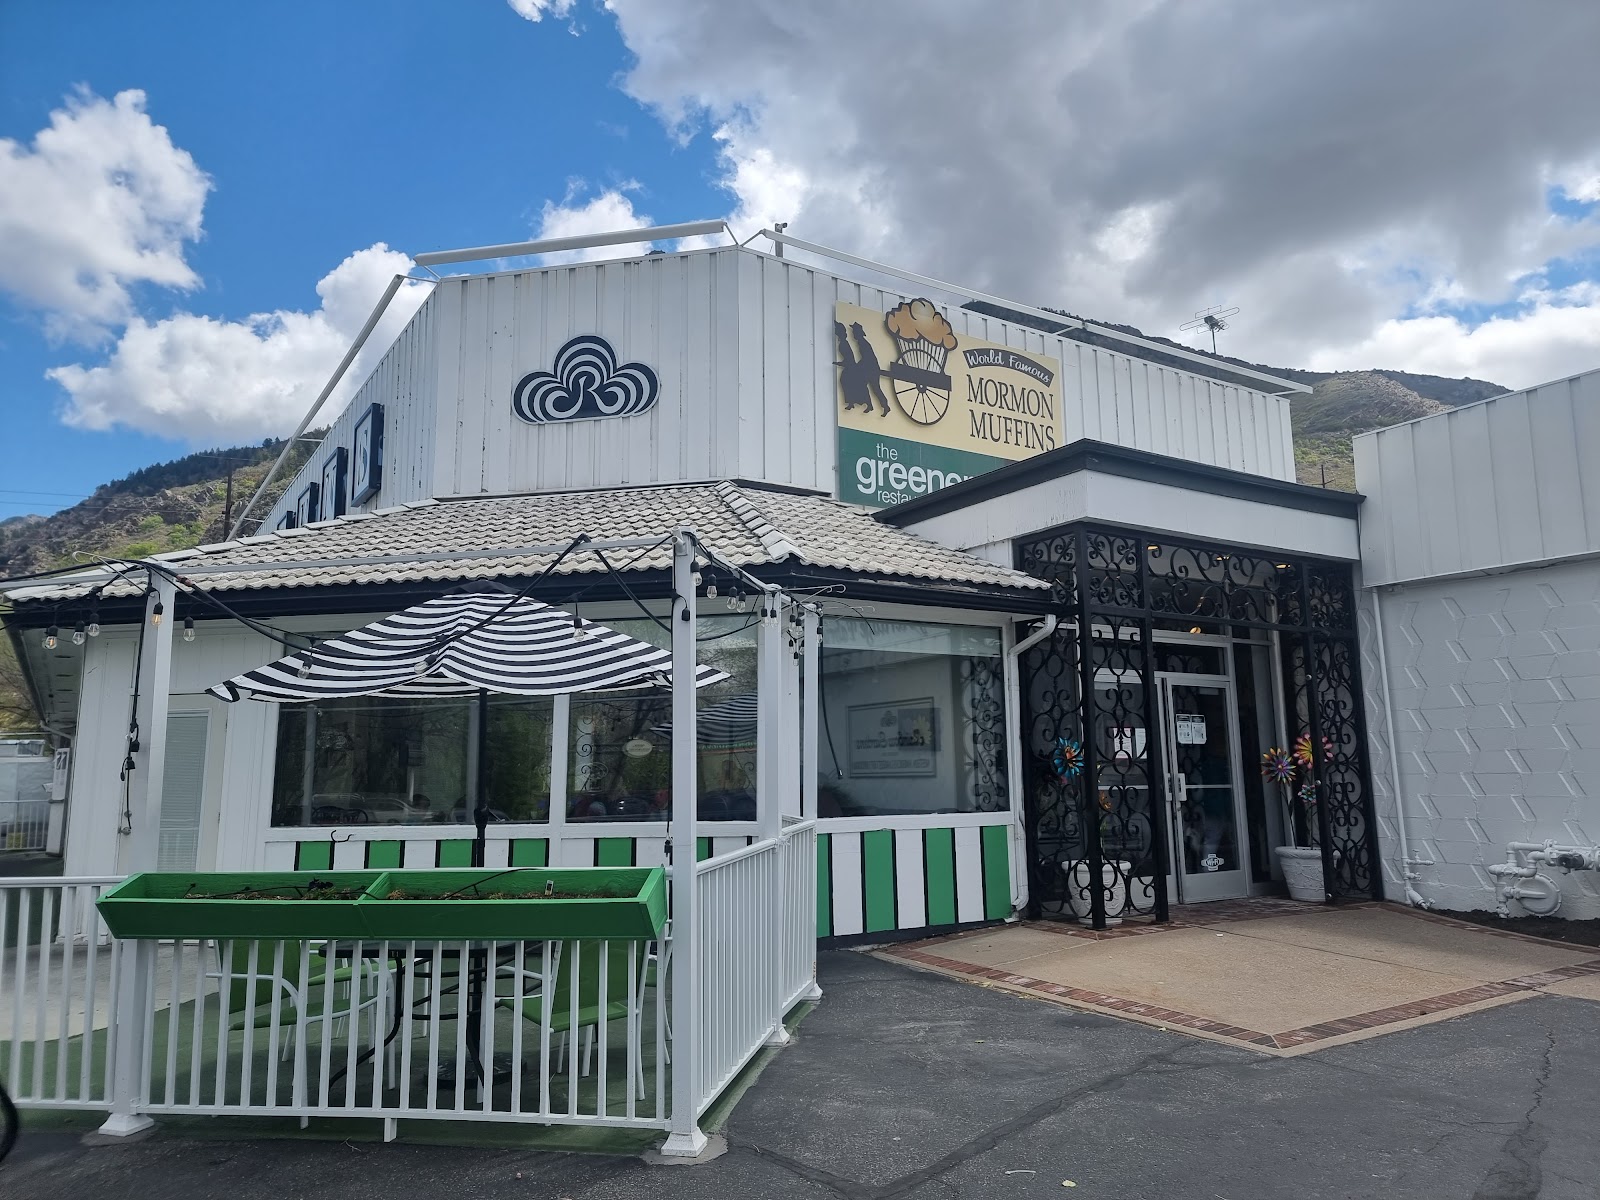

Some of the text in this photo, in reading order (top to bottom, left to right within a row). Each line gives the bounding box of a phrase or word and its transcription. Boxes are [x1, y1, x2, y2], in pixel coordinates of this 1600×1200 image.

[966, 349, 1050, 383] World Famous
[966, 374, 1054, 421] MORMON
[969, 409, 1055, 451] MUFFINS
[876, 443, 898, 461] the
[855, 456, 975, 494] green
[877, 488, 916, 505] resta
